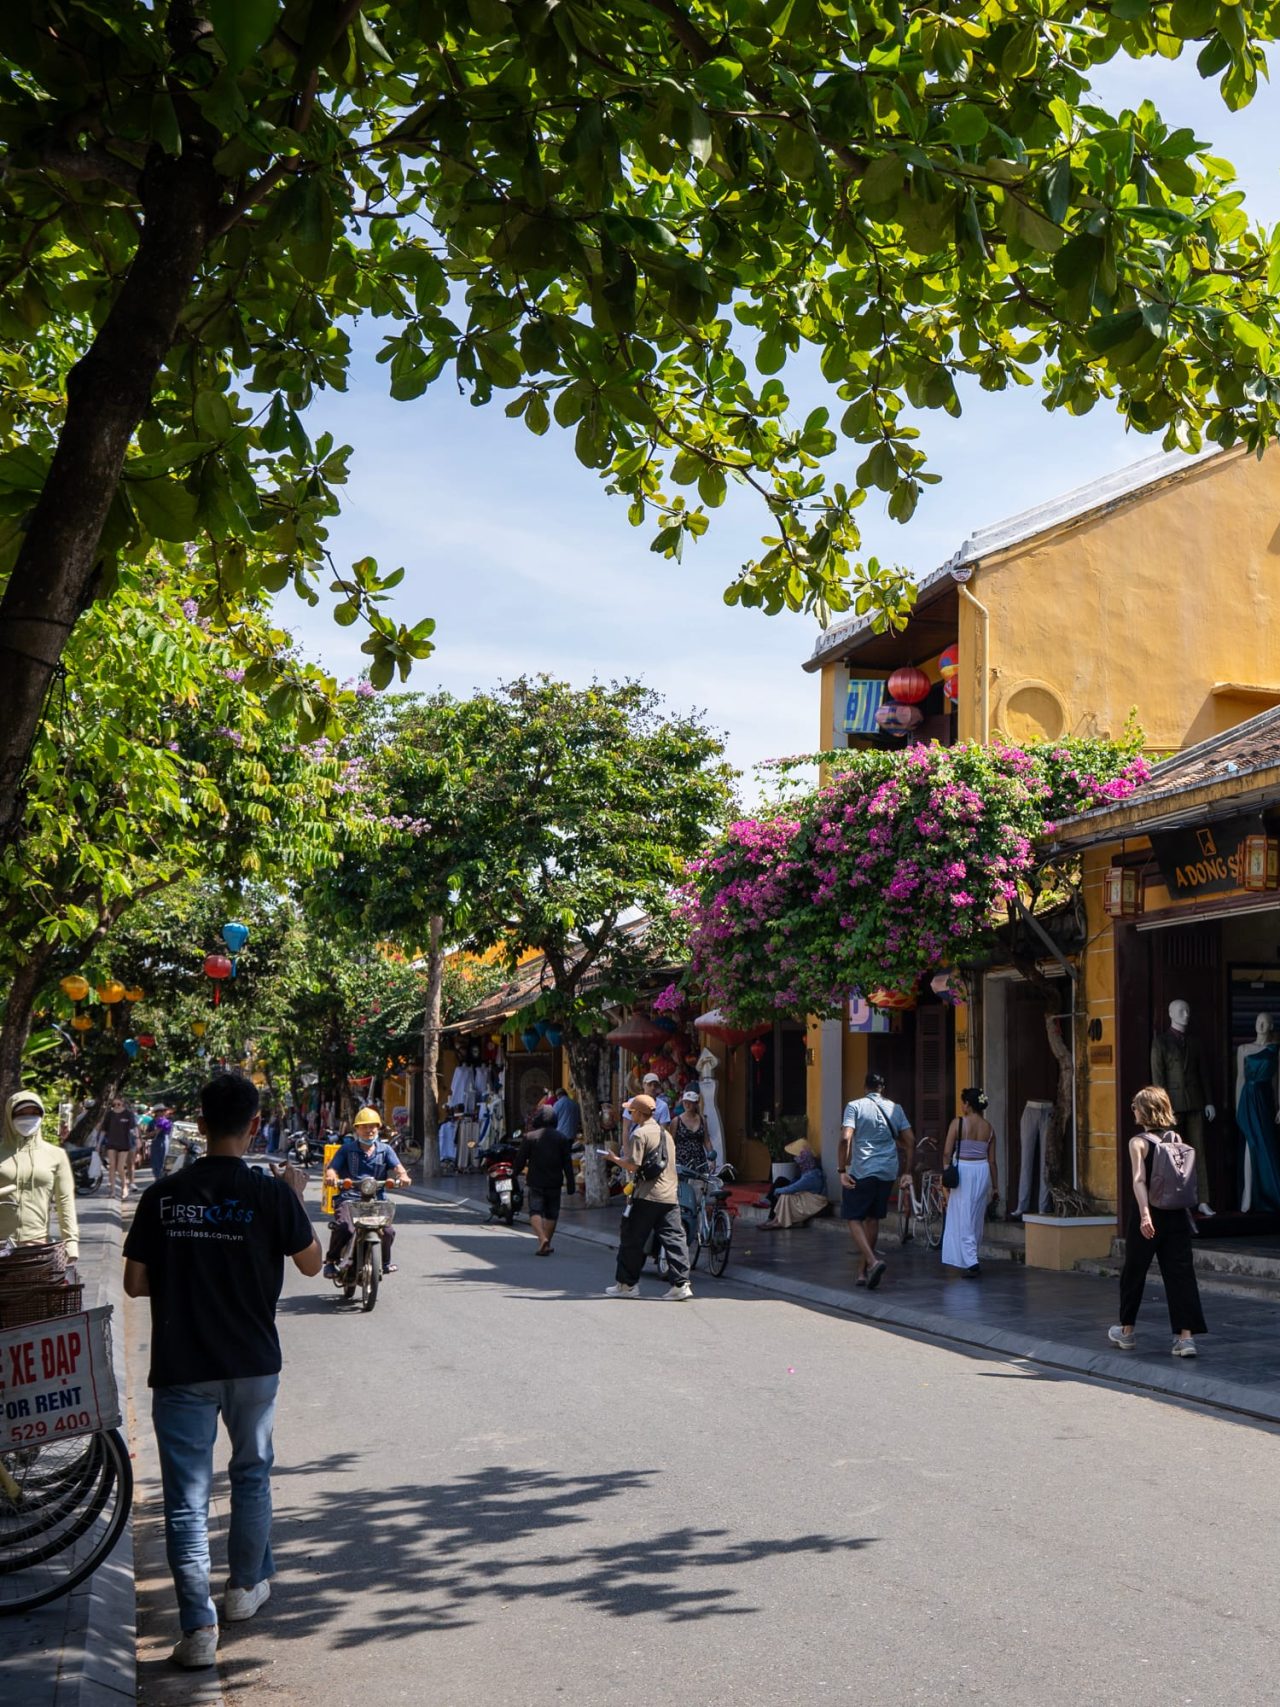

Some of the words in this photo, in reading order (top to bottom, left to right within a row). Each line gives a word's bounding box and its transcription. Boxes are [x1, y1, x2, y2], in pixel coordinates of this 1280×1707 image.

[1175, 866, 1188, 888] A
[9, 1342, 37, 1387] XE
[41, 1332, 81, 1385] ĐẠP
[35, 1387, 82, 1414] RENT
[11, 1420, 47, 1442] 529
[55, 1411, 91, 1432] 400
